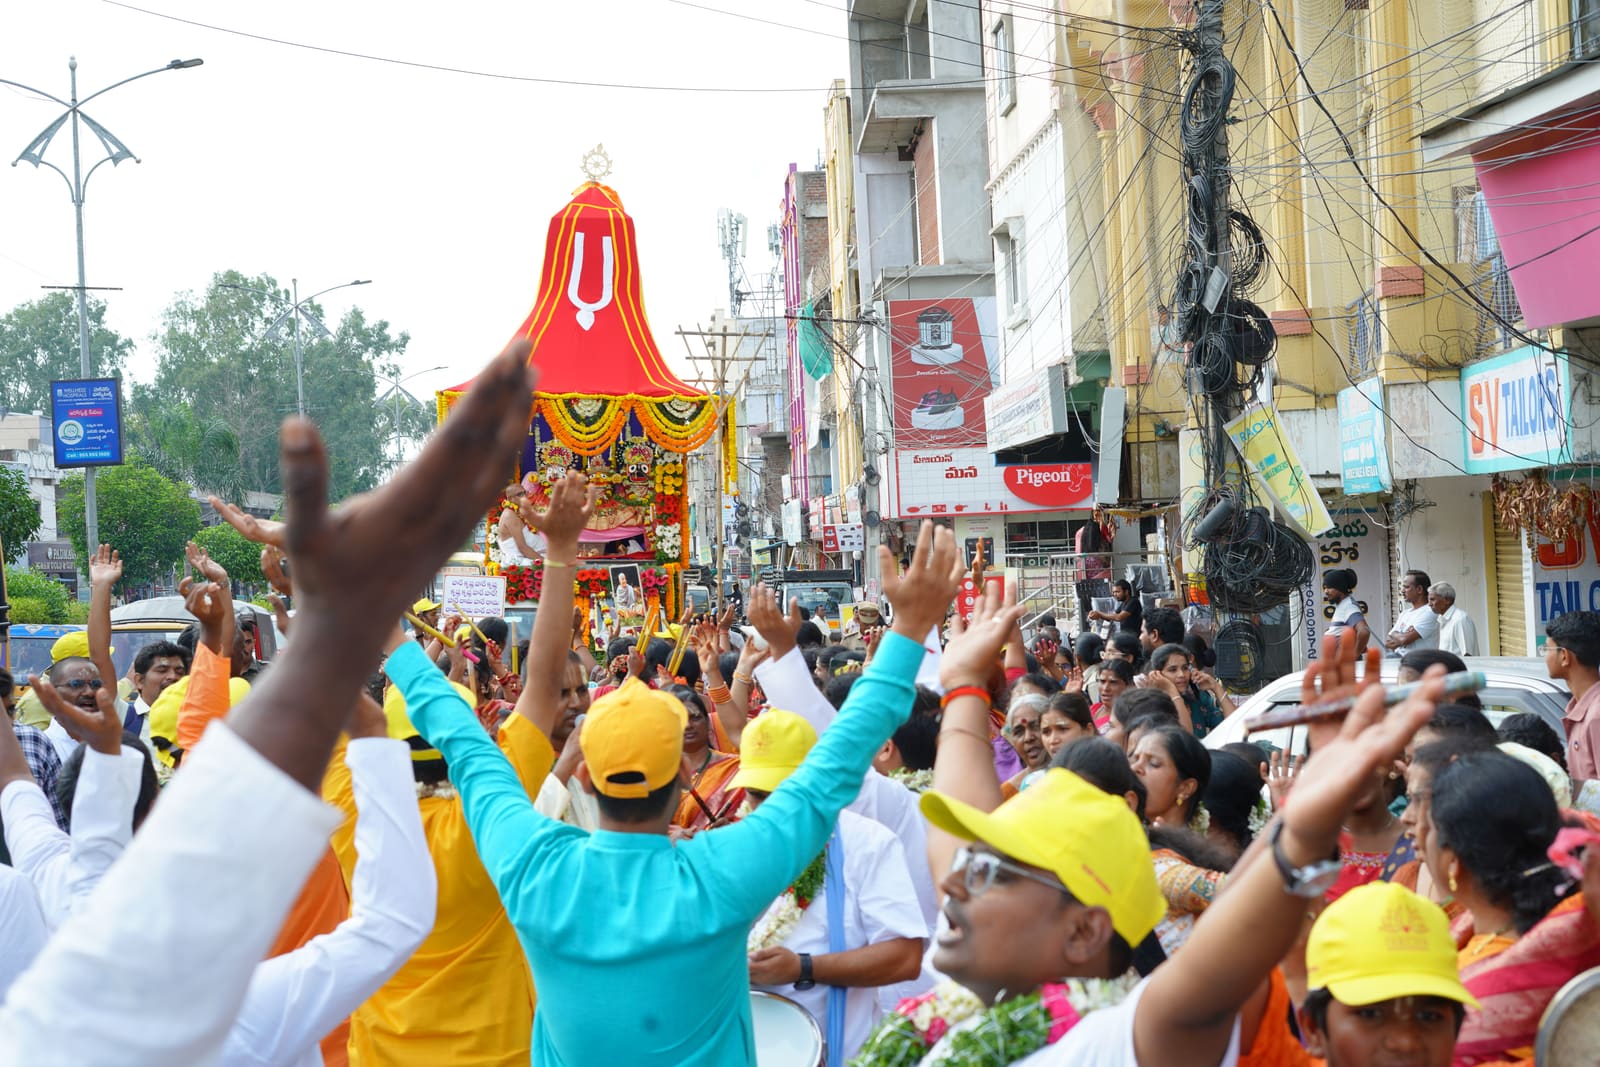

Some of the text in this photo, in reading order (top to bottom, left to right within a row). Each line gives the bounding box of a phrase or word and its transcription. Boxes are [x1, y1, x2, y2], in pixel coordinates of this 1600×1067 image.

[1469, 367, 1558, 455] SV TAILORS
[944, 465, 978, 479] మన
[1016, 469, 1071, 487] Pigeon
